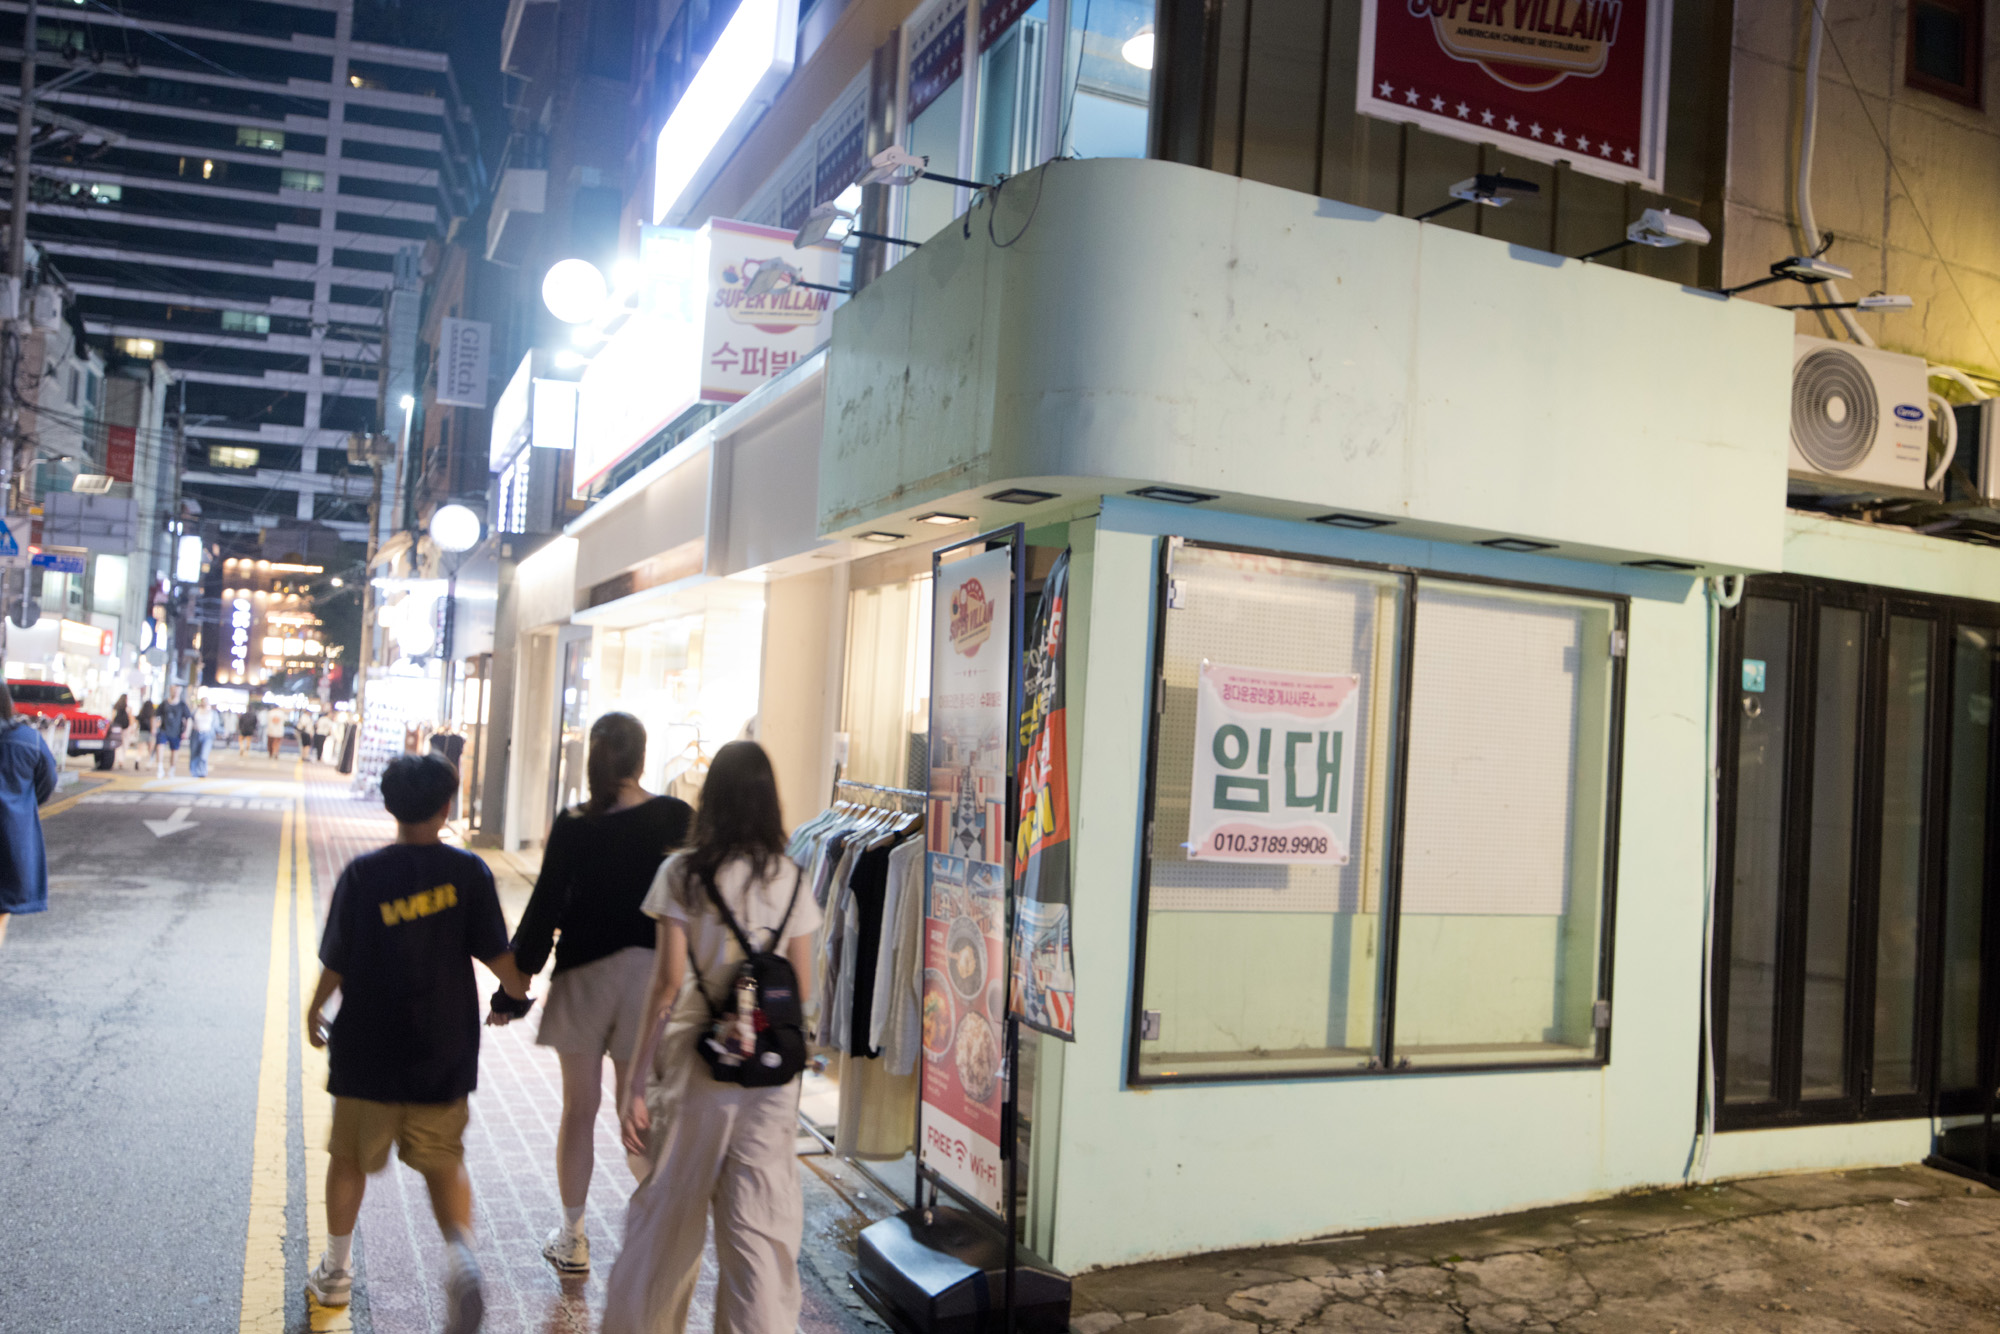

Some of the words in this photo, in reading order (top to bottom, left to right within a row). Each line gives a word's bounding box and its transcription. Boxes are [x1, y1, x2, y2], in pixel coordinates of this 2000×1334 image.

[1456, 27, 1501, 41] AMERICAN
[1514, 0, 1618, 43] VILLAIN
[771, 290, 831, 311] VILLAIN
[458, 327, 480, 395] Glitch
[711, 341, 806, 378] 수퍼빌
[1212, 724, 1343, 813] 임대
[1214, 833, 1328, 854] 010.3189.9908
[928, 1125, 952, 1158] FREE
[969, 1152, 996, 1188] Wi-Fi
